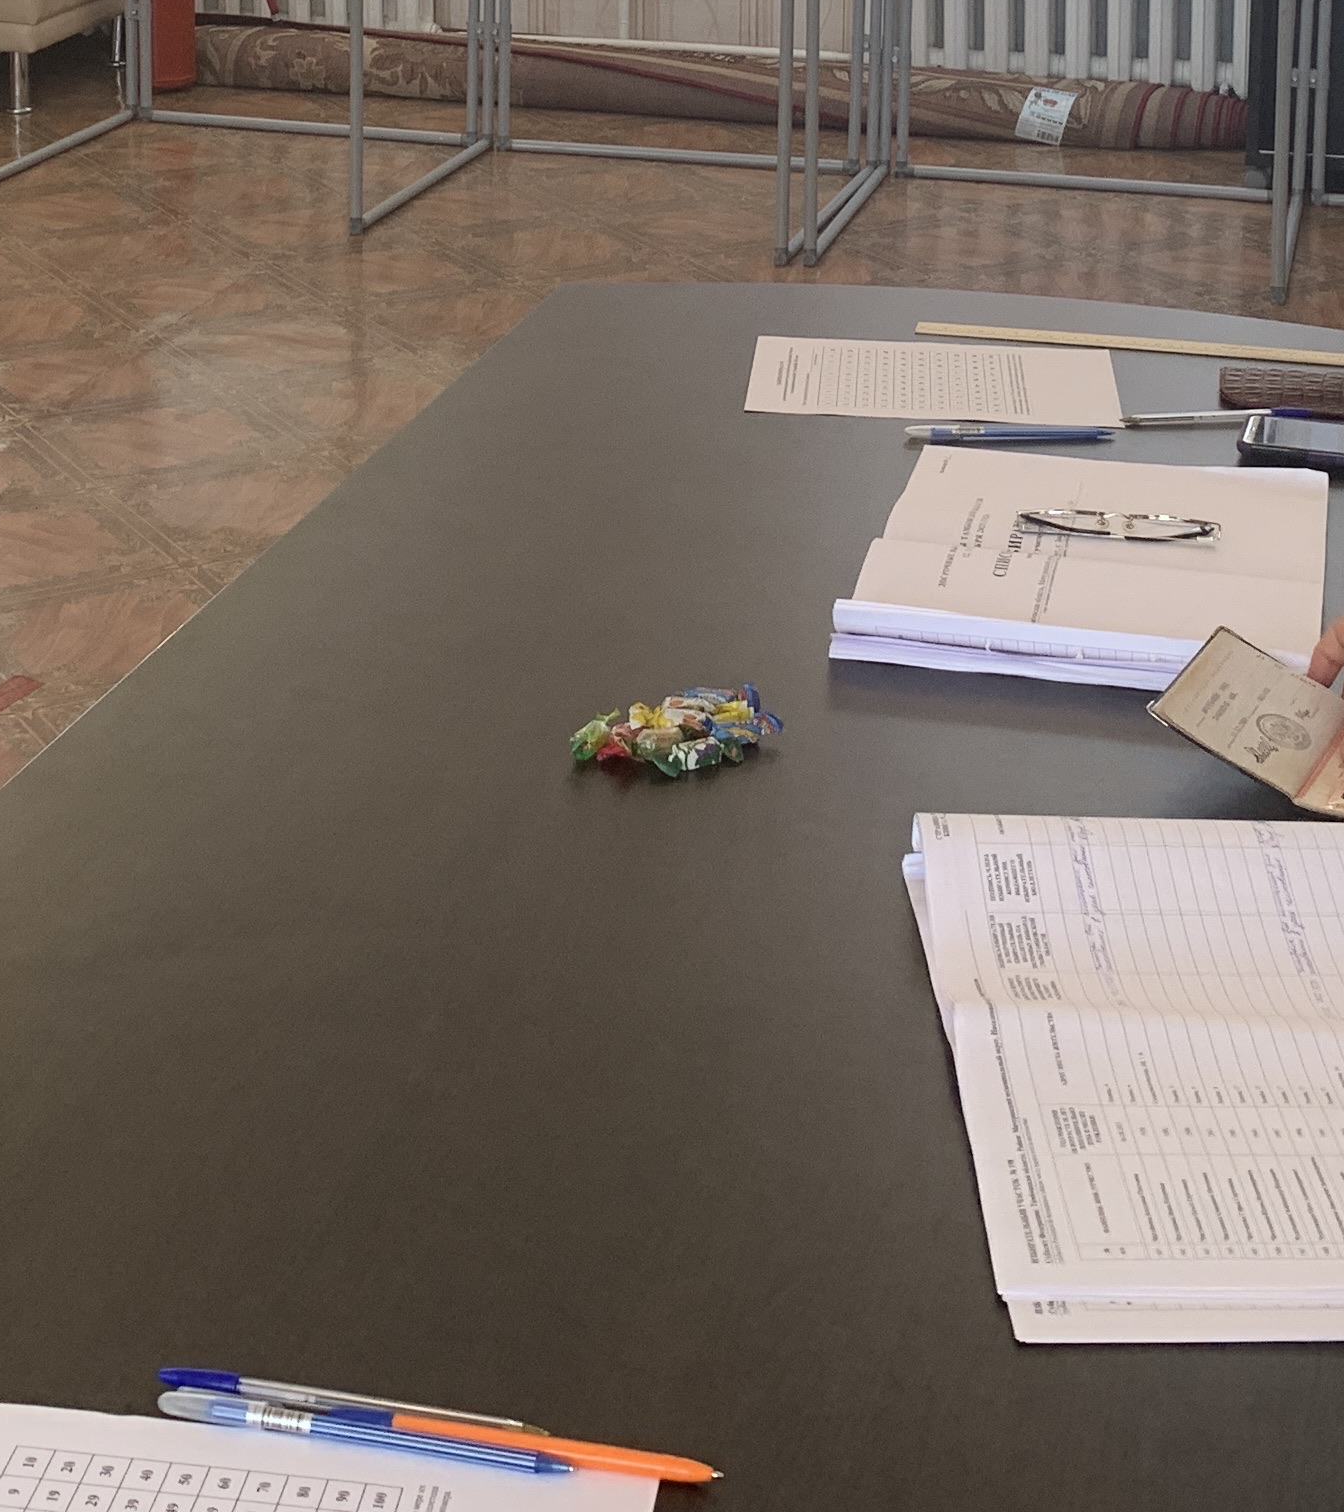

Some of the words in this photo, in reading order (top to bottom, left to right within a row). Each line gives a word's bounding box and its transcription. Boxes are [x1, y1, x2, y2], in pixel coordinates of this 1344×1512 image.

[22, 1456, 37, 1468] 10
[60, 1460, 76, 1473] 20
[99, 1465, 115, 1478] 30
[139, 1469, 154, 1482] 40
[178, 1473, 193, 1486] 50
[217, 1477, 233, 1490] 60
[256, 1481, 271, 1493] 70
[296, 1486, 311, 1498] 80
[46, 1490, 61, 1502] 19
[85, 1494, 100, 1508] 29
[335, 1490, 351, 1502] 90
[372, 1491, 387, 1510] 100
[124, 1498, 139, 1511] 39
